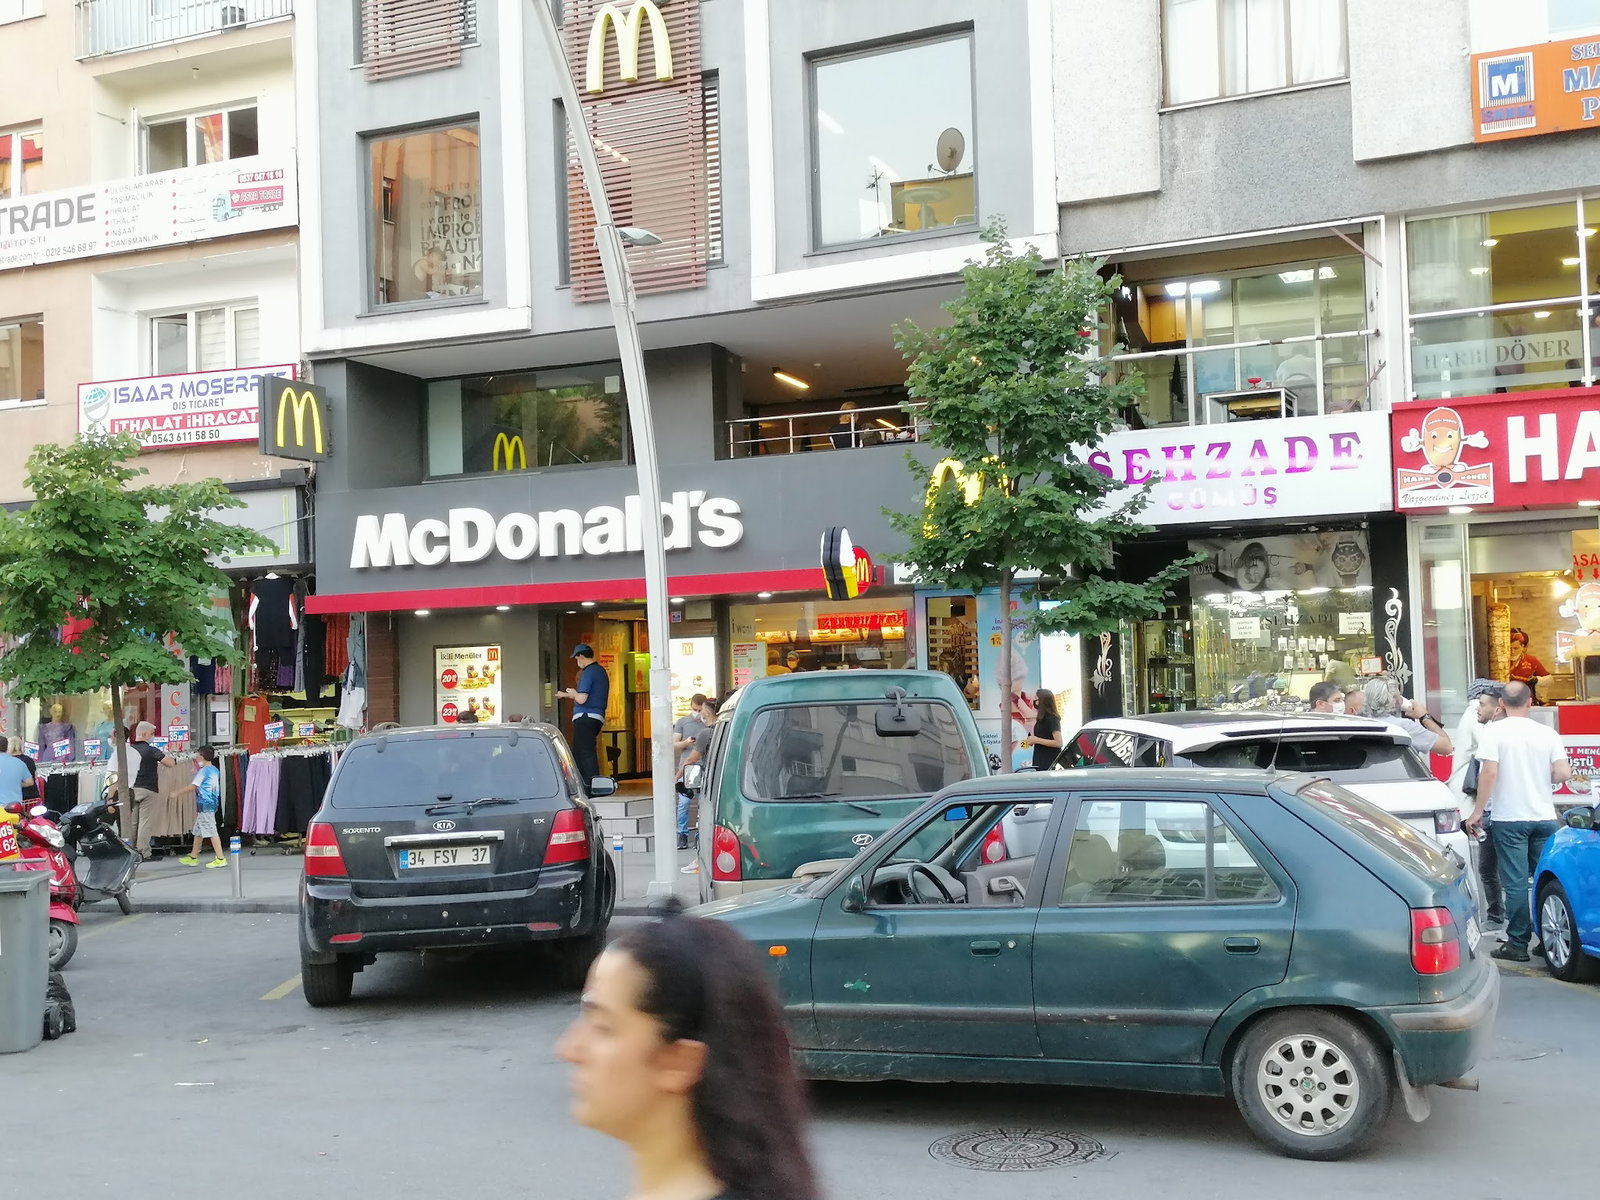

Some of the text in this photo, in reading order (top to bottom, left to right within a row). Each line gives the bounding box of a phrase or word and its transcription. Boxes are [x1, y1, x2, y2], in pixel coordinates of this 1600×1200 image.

[1572, 42, 1600, 60] SE
[1496, 339, 1572, 363] DÖNER
[113, 383, 174, 404] ISAAR
[152, 429, 221, 445] 0543 611 58 50
[350, 489, 744, 569] McDonald's
[342, 826, 381, 835] SORENTO
[436, 821, 453, 830] KIA
[409, 852, 425, 866] 34
[433, 849, 458, 864] FSV
[472, 847, 488, 862] 37
